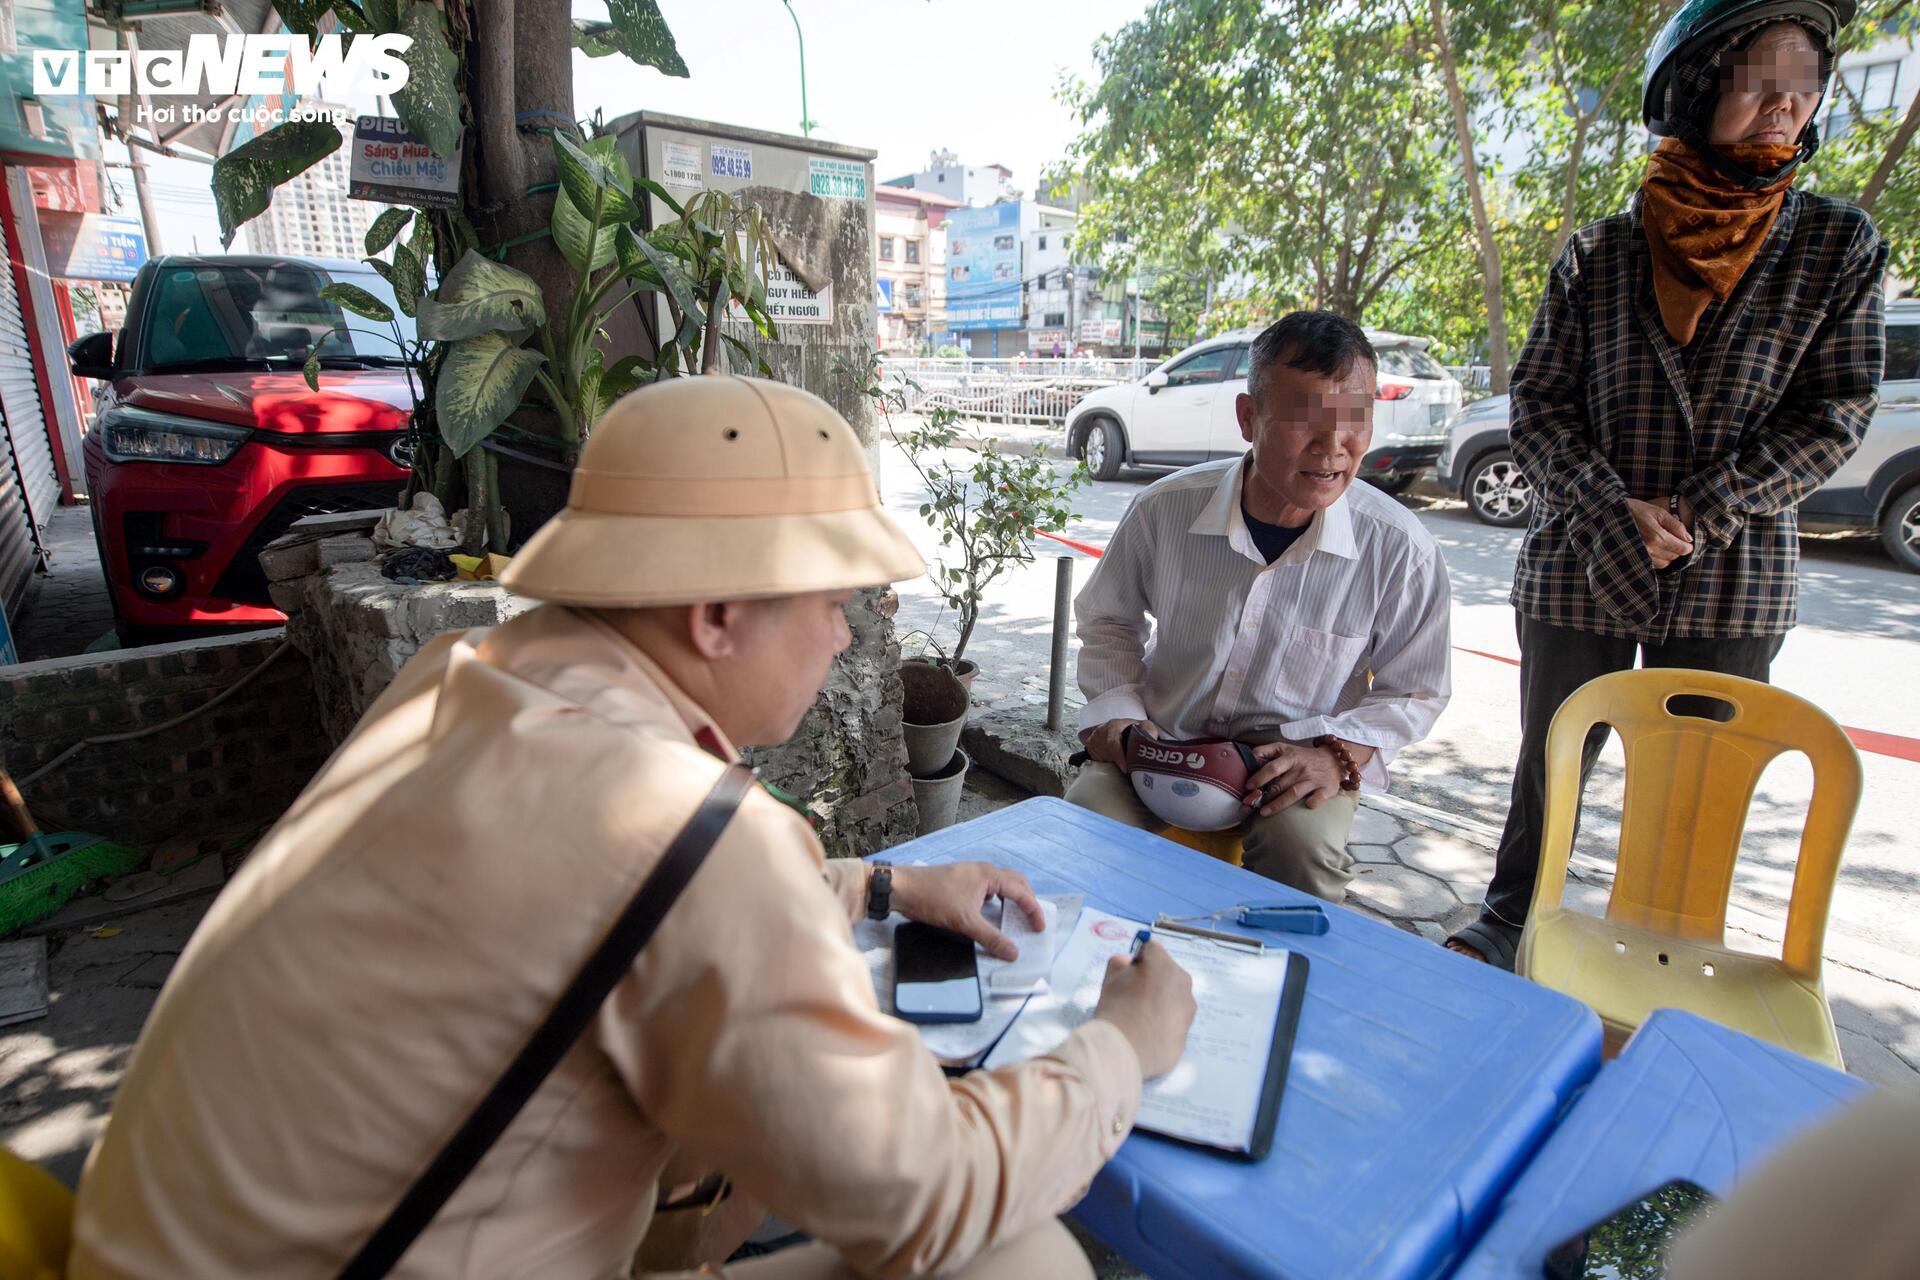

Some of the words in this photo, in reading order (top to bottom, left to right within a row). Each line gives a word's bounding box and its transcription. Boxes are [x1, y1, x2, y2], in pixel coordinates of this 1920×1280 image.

[364, 143, 398, 160] Sáng
[370, 160, 411, 176] Chiều
[768, 286, 788, 300] GUY
[766, 301, 786, 316] HẾT
[788, 303, 820, 317] NGƯỜI
[1137, 744, 1184, 765] GREE
